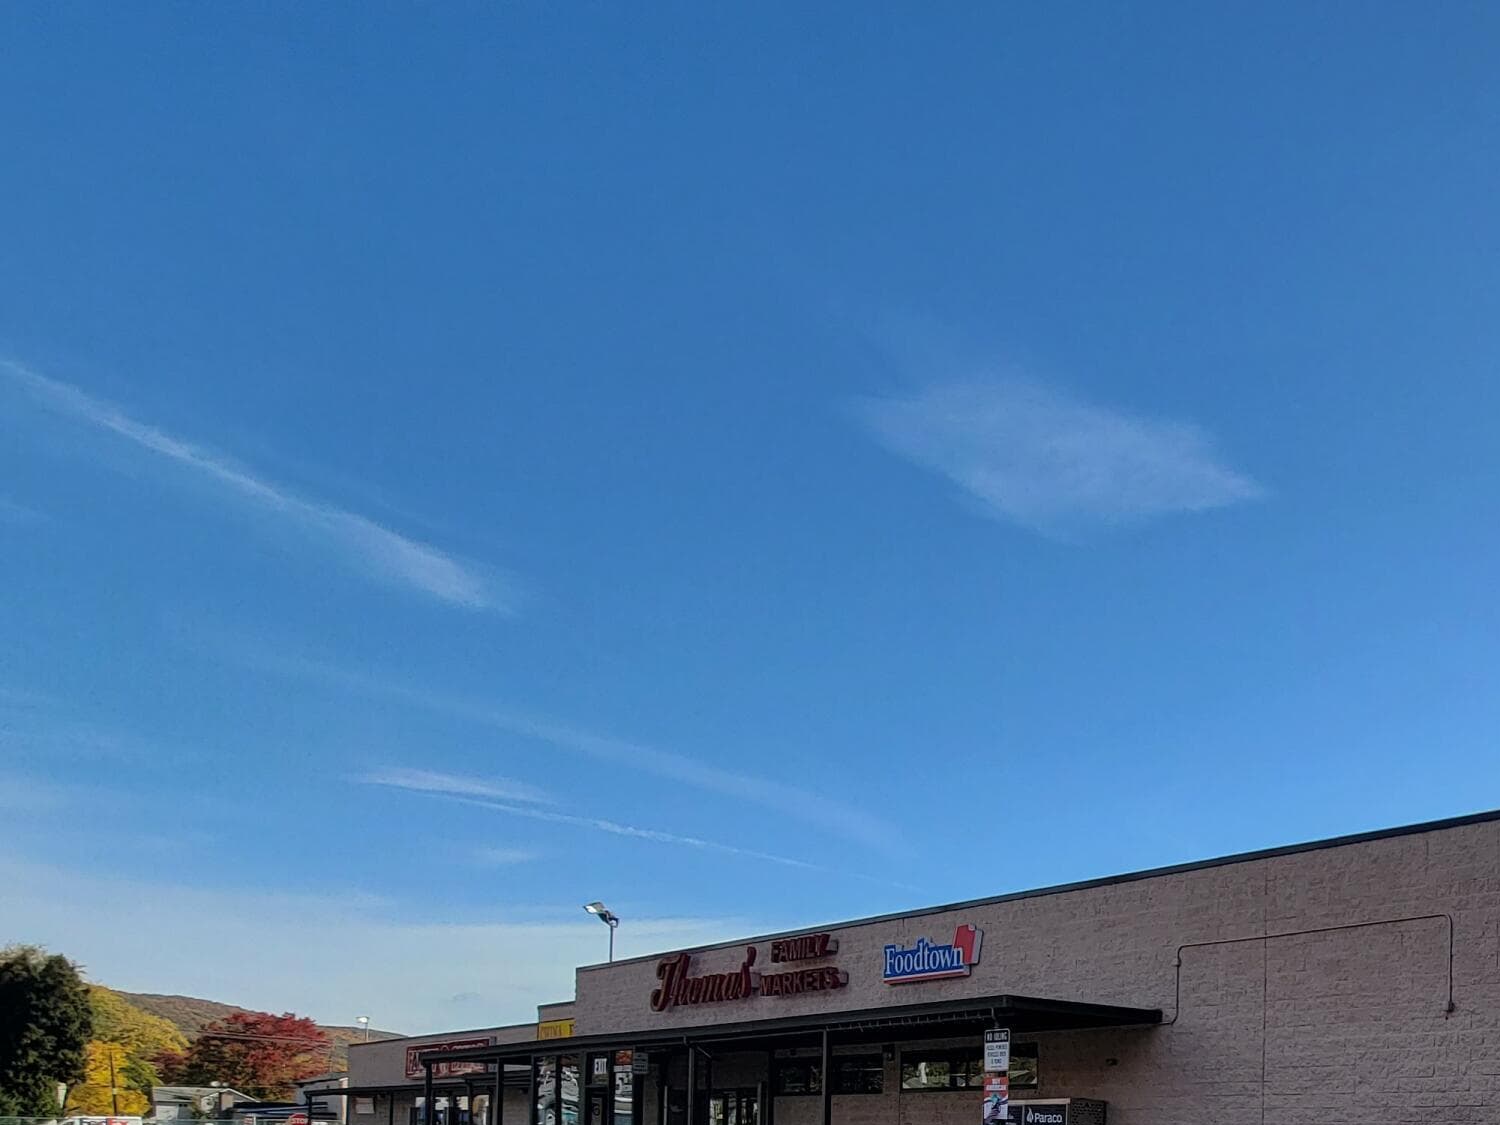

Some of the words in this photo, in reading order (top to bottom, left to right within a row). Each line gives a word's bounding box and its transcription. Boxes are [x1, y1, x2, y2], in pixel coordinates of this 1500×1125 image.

[771, 934, 831, 963] FAMILY
[885, 941, 964, 975] Foodtown
[651, 946, 757, 1012] Thomas'
[759, 966, 842, 996] MARKETS
[1034, 1112, 1063, 1123] Paraco
